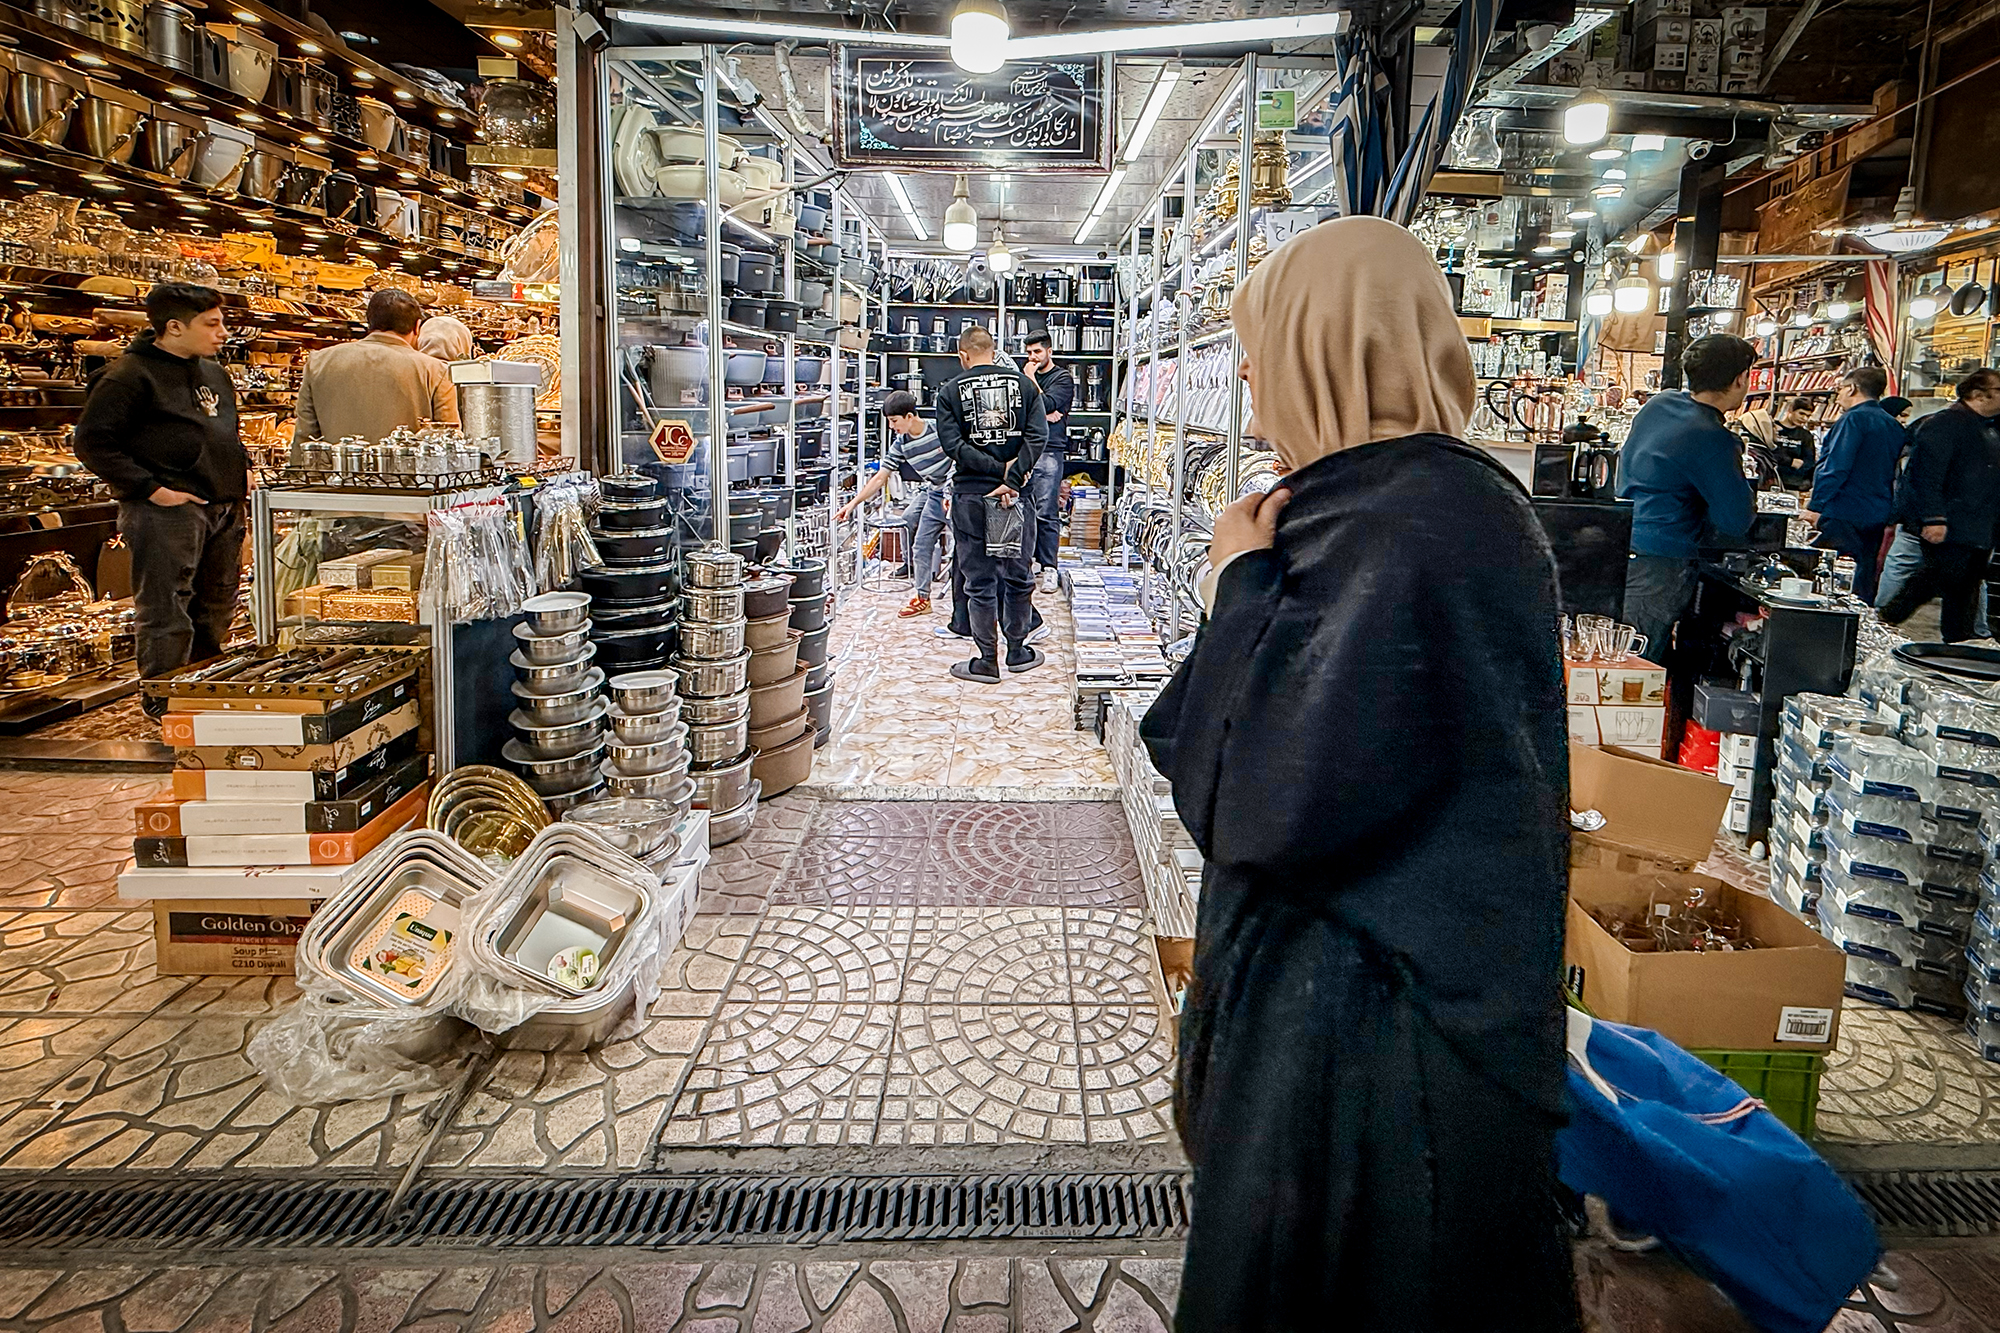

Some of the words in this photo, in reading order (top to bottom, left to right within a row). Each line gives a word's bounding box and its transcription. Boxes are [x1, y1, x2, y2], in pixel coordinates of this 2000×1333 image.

[201, 916, 266, 932] Golden
[269, 919, 305, 935] Opa
[409, 923, 434, 940] Unique
[233, 946, 257, 956] Soup
[231, 959, 255, 969] C210
[256, 960, 287, 969] Diwali
